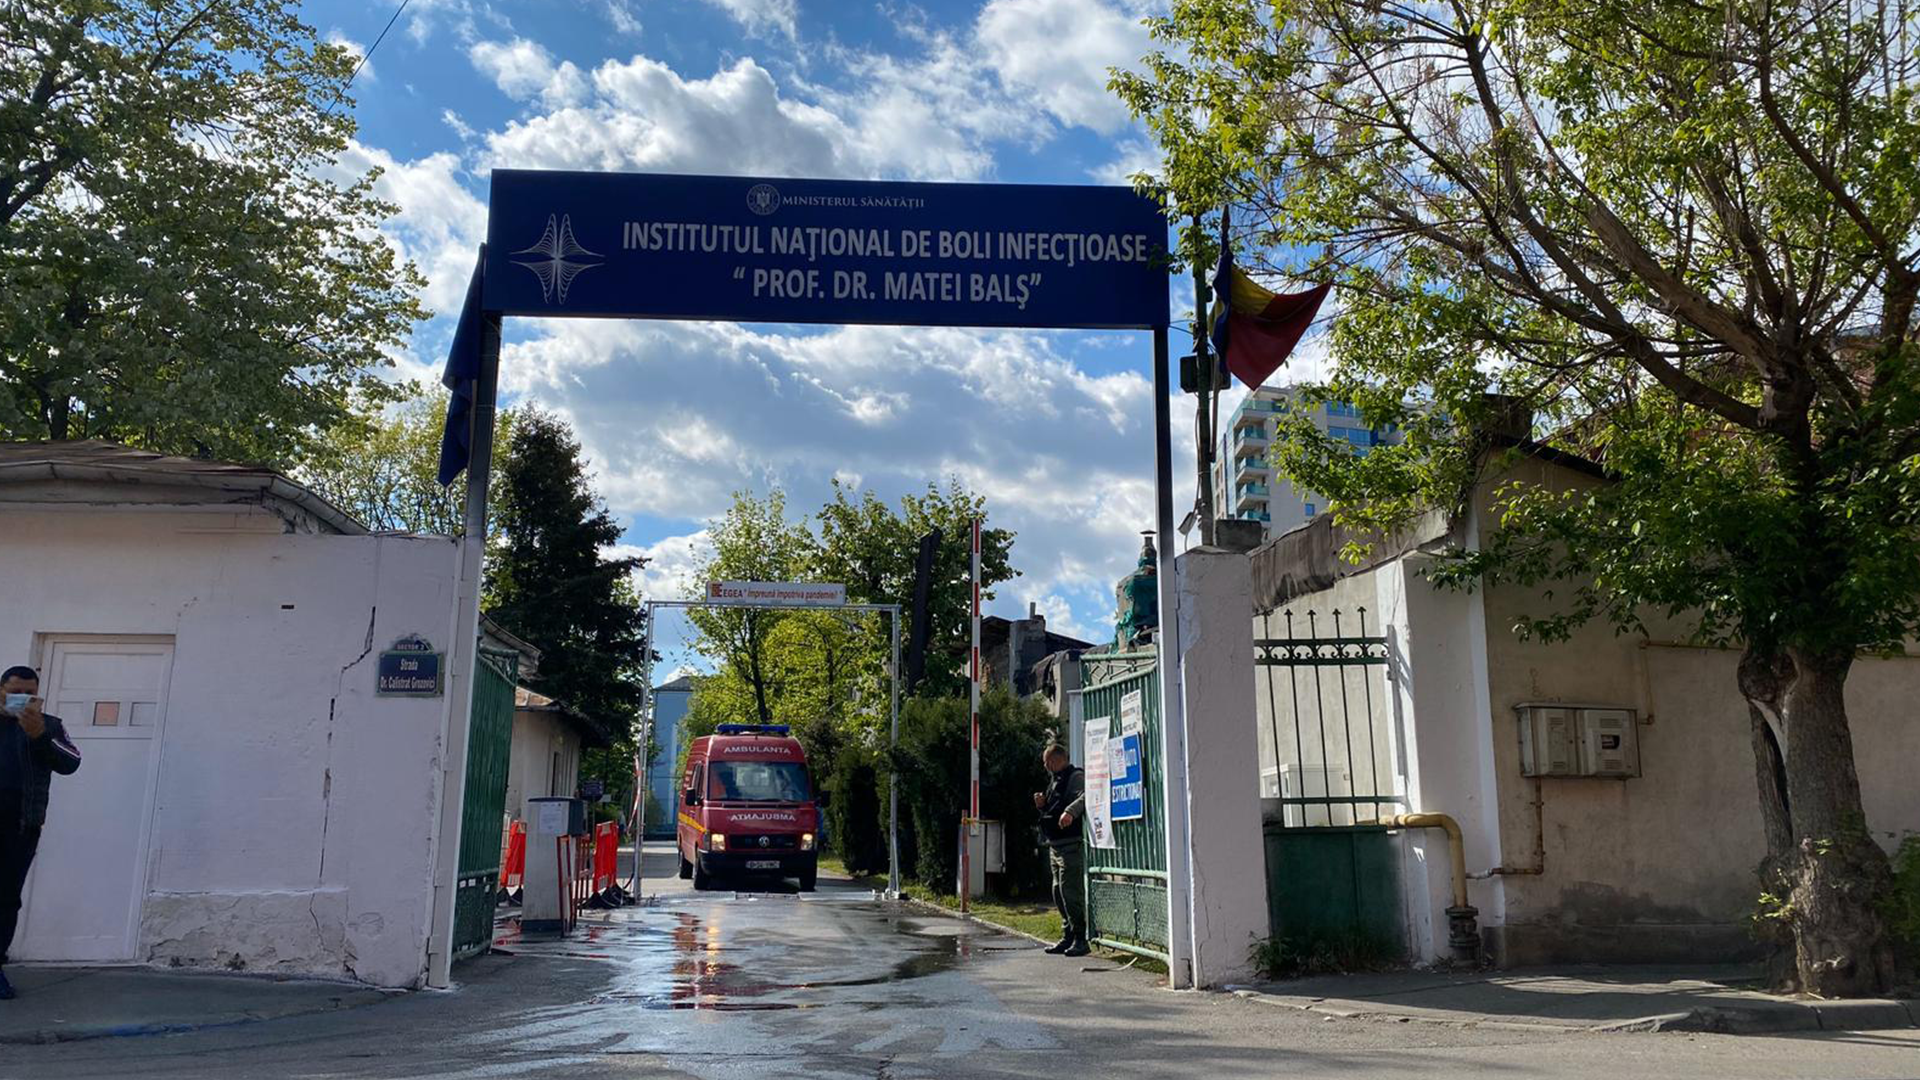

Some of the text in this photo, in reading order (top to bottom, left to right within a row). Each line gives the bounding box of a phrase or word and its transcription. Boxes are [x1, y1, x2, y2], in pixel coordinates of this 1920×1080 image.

[782, 196, 858, 207] MINISTERUL
[623, 221, 764, 254] INSTITUTUL
[901, 229, 931, 258] DE
[938, 231, 991, 260] BOLI
[753, 269, 825, 299] PROF.
[833, 271, 875, 300] DR.
[884, 272, 961, 301] MATEI
[400, 658, 418, 671] Strada
[380, 676, 388, 689] Dr.
[389, 676, 411, 689] Calistrat
[723, 746, 792, 754] AMBULANTA
